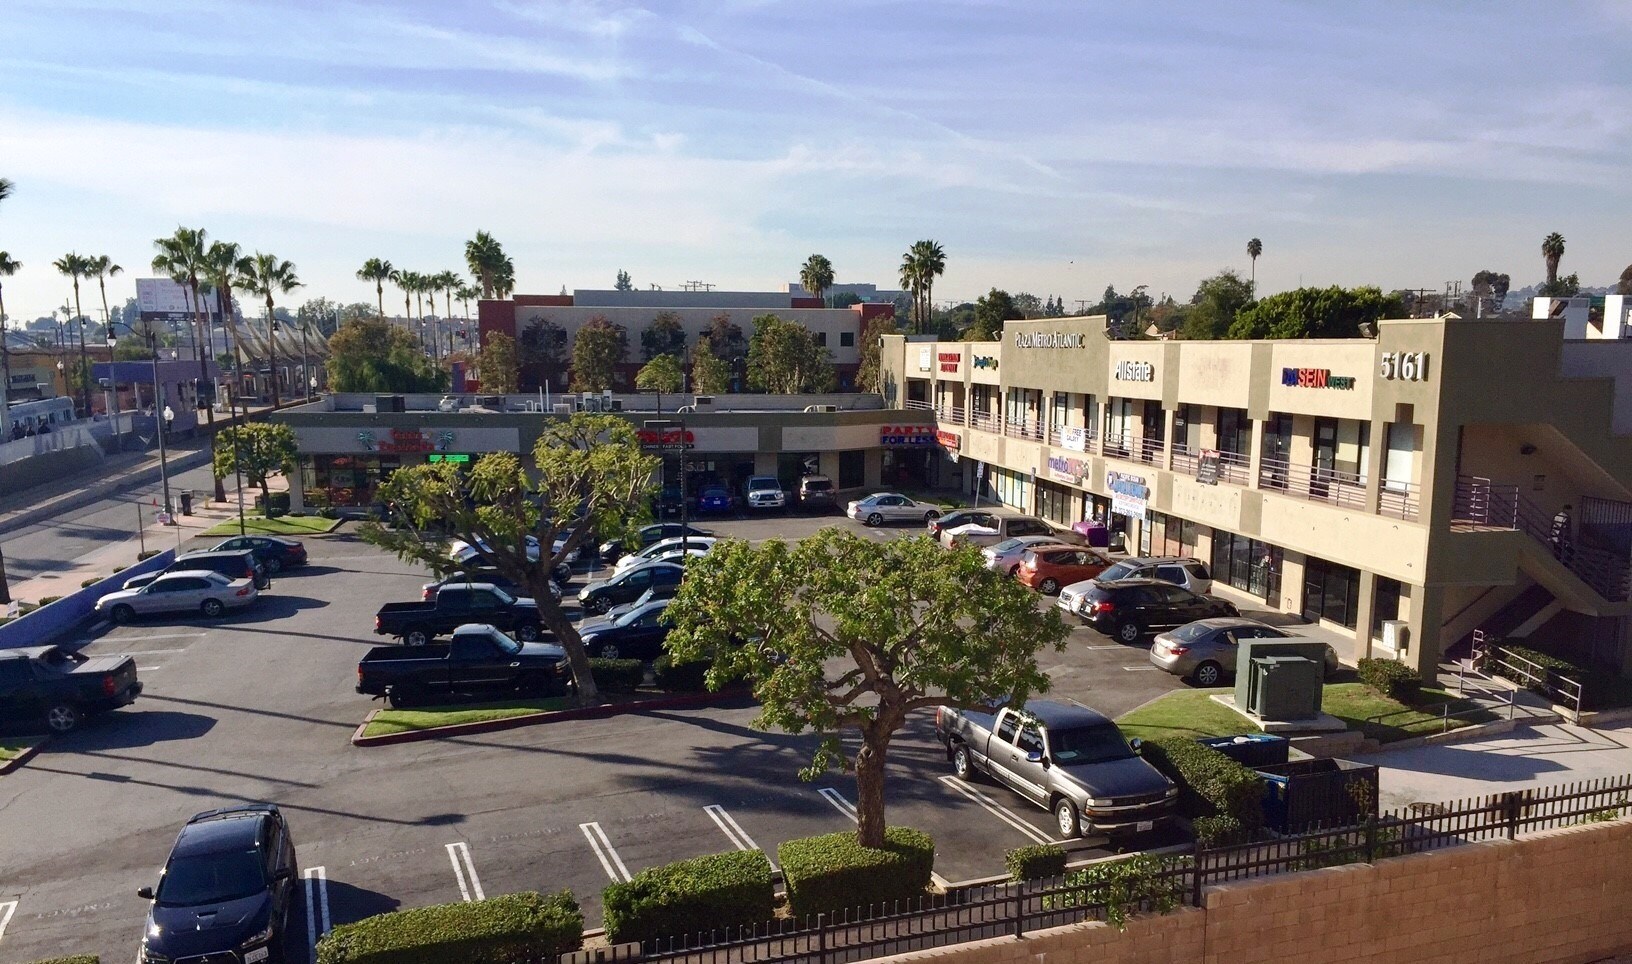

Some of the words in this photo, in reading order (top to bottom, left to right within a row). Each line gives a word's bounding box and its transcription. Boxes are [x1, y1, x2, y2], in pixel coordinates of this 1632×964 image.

[1015, 331, 1031, 348] PLAZA
[1032, 331, 1051, 348] METRO
[1052, 331, 1083, 349] ATLANTIC
[1115, 361, 1151, 381] Allstate
[1380, 351, 1425, 380] 5161
[882, 426, 938, 435] PARTY
[883, 435, 905, 445] FOR
